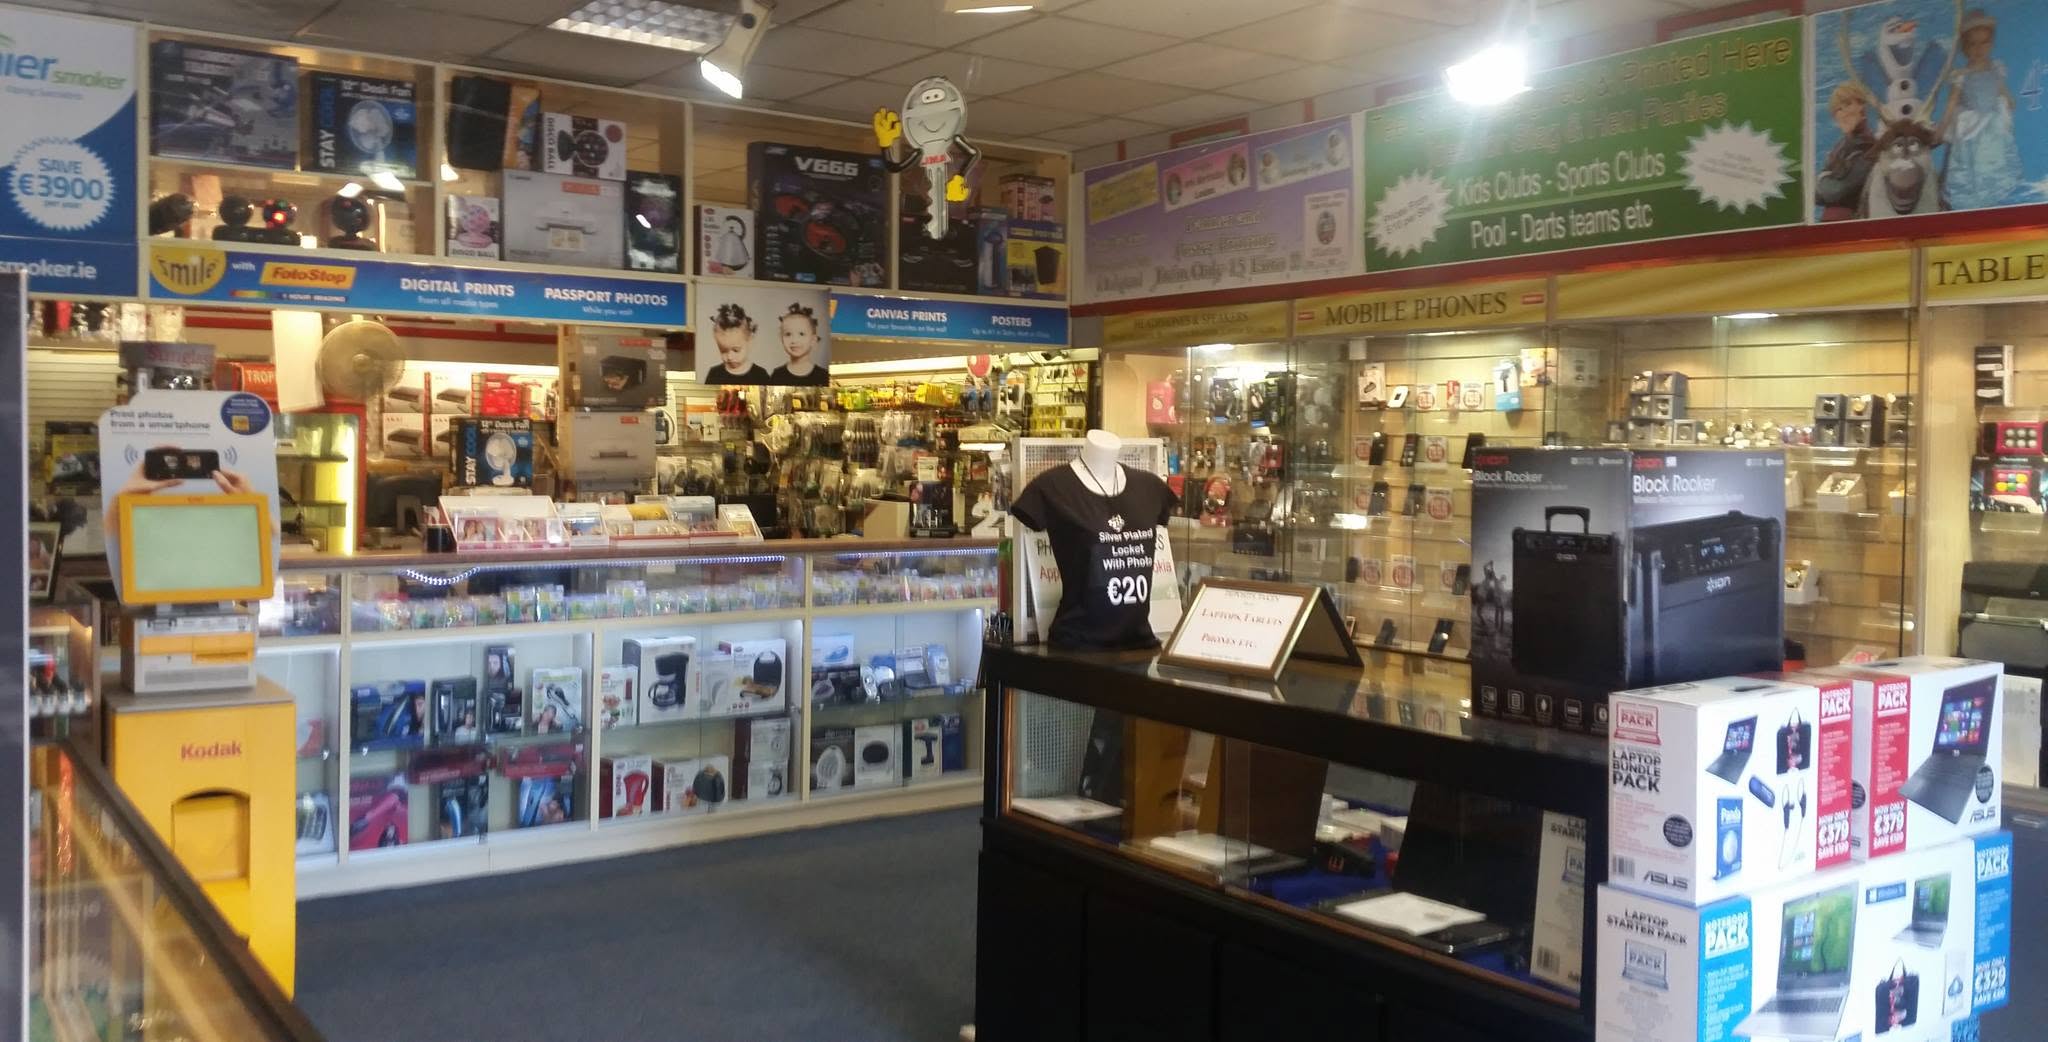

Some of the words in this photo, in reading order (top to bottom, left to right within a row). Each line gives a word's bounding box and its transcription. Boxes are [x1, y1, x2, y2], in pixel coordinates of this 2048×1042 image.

[1622, 43, 1712, 85] Printed
[1721, 36, 1793, 74] Here
[52, 69, 127, 90] smoker
[360, 82, 388, 94] Desk
[391, 86, 412, 97] Fan
[1644, 90, 1729, 129] Parties
[320, 129, 336, 168] STAY
[38, 158, 83, 175] SAVE
[794, 156, 859, 177] V666
[1457, 175, 1492, 206] Kids
[1495, 168, 1542, 201] Clubs
[1557, 158, 1610, 198] Sports
[1615, 147, 1666, 182] Clubs
[18, 173, 104, 201] €3900
[1471, 217, 1507, 249] Pool
[1521, 211, 1567, 243] Darts
[1570, 204, 1621, 235] teams
[1624, 200, 1654, 230] etc
[232, 262, 256, 273] with
[272, 267, 347, 284] FotoStop
[401, 278, 461, 294] DIGITAL
[465, 282, 515, 297] PRINTS
[544, 287, 611, 303] PASSPORT
[615, 292, 668, 307] PHOTOS
[866, 308, 910, 320] CANVAS
[911, 310, 948, 323] PRINTS
[1325, 301, 1408, 327] MOBILE
[1413, 292, 1507, 320] PHONES
[991, 315, 1032, 327] POSTERS
[138, 411, 174, 420] photos
[148, 420, 210, 431] smartphone
[464, 456, 477, 486] STAY
[1474, 470, 1502, 482] Block
[1505, 471, 1544, 483] Rocker
[1632, 474, 1670, 494] Block
[1672, 474, 1717, 493] Rocker
[1099, 531, 1122, 544] Silver
[1122, 528, 1154, 541] Plated
[1111, 543, 1145, 557] Locket
[1102, 558, 1126, 571] With
[1107, 574, 1148, 606] €20
[1821, 694, 1851, 718] PACK
[1878, 690, 1908, 711] PACK
[1621, 713, 1654, 728] PACK
[180, 740, 241, 761] Kodak
[1612, 749, 1662, 766] LAPTOP
[1612, 761, 1661, 778] BUNDLE
[1612, 771, 1661, 793] PACK
[1720, 806, 1742, 826] Panda
[1968, 805, 1996, 824] ASUS
[1976, 853, 2009, 877] PACK
[1643, 869, 1689, 890] ASUS
[1624, 907, 1669, 927] LAPTOP
[1606, 915, 1655, 936] STARTER
[1657, 928, 1688, 945] PACK
[1705, 922, 1749, 955] PACK
[1629, 951, 1662, 969] PACK
